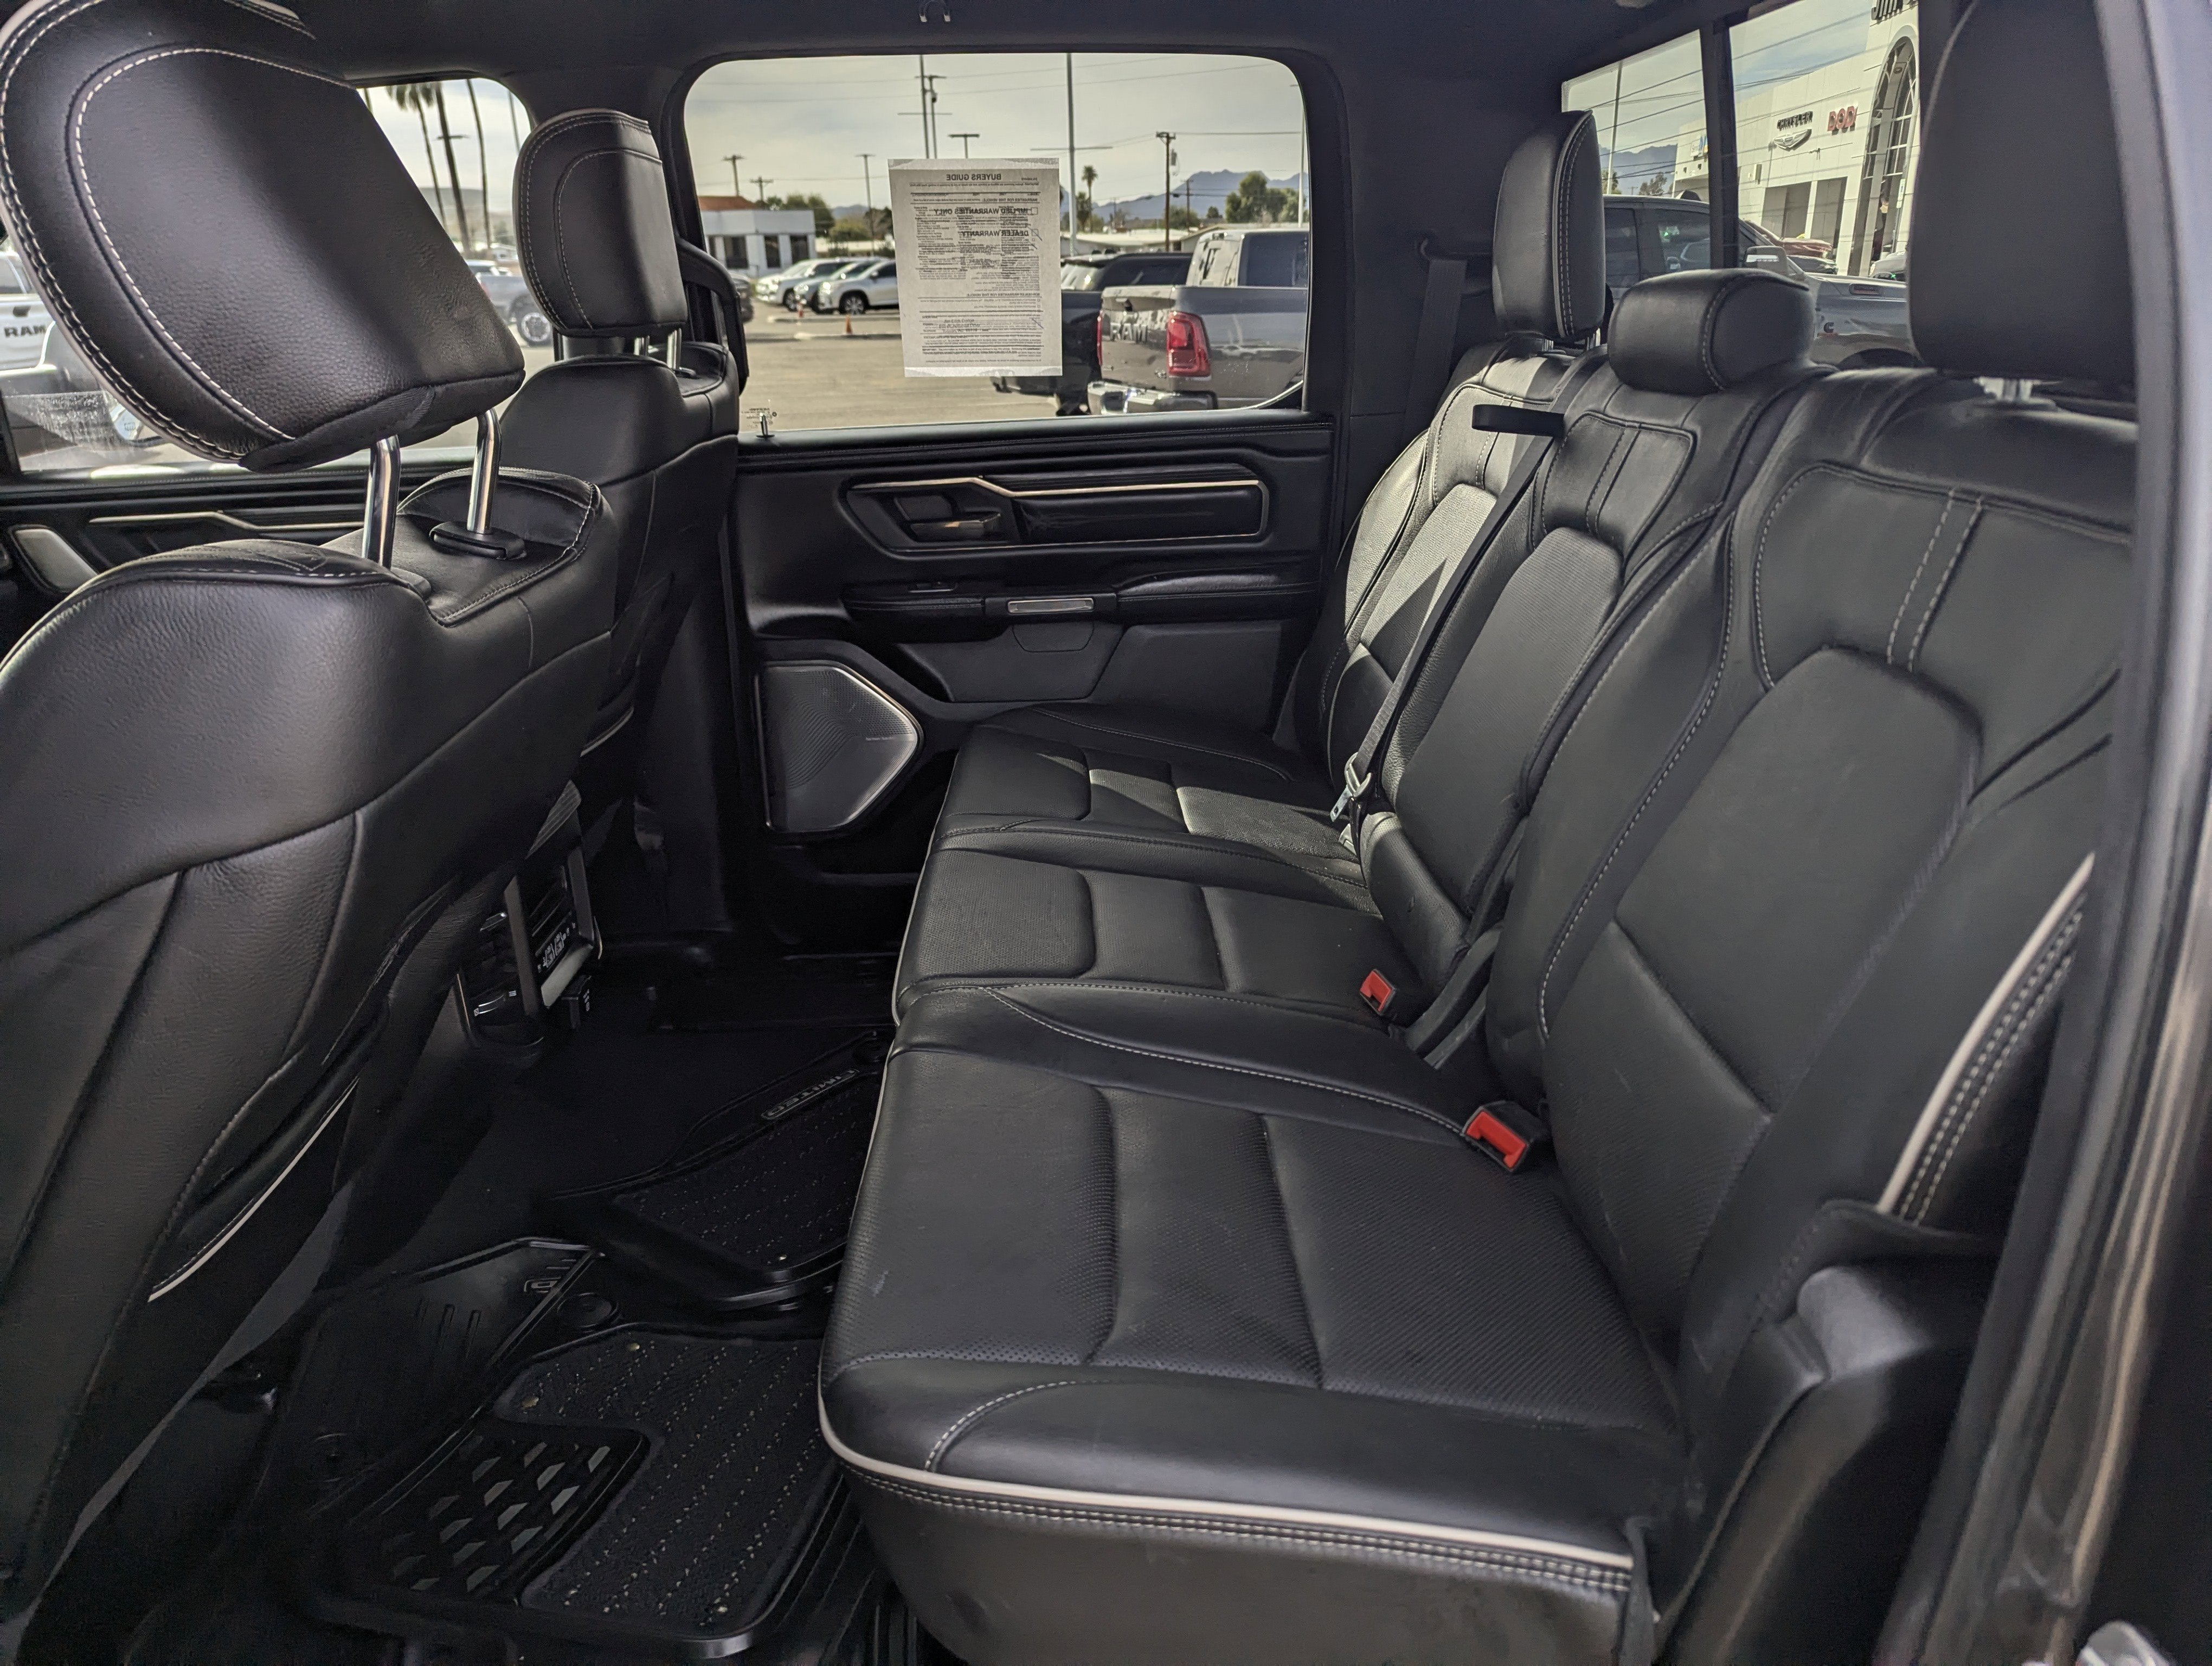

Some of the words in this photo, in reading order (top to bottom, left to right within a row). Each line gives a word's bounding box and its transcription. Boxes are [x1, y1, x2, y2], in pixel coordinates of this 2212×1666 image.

[1827, 106, 1859, 132] DOD
[4, 325, 46, 337] RAM
[1110, 322, 1148, 343] RAM
